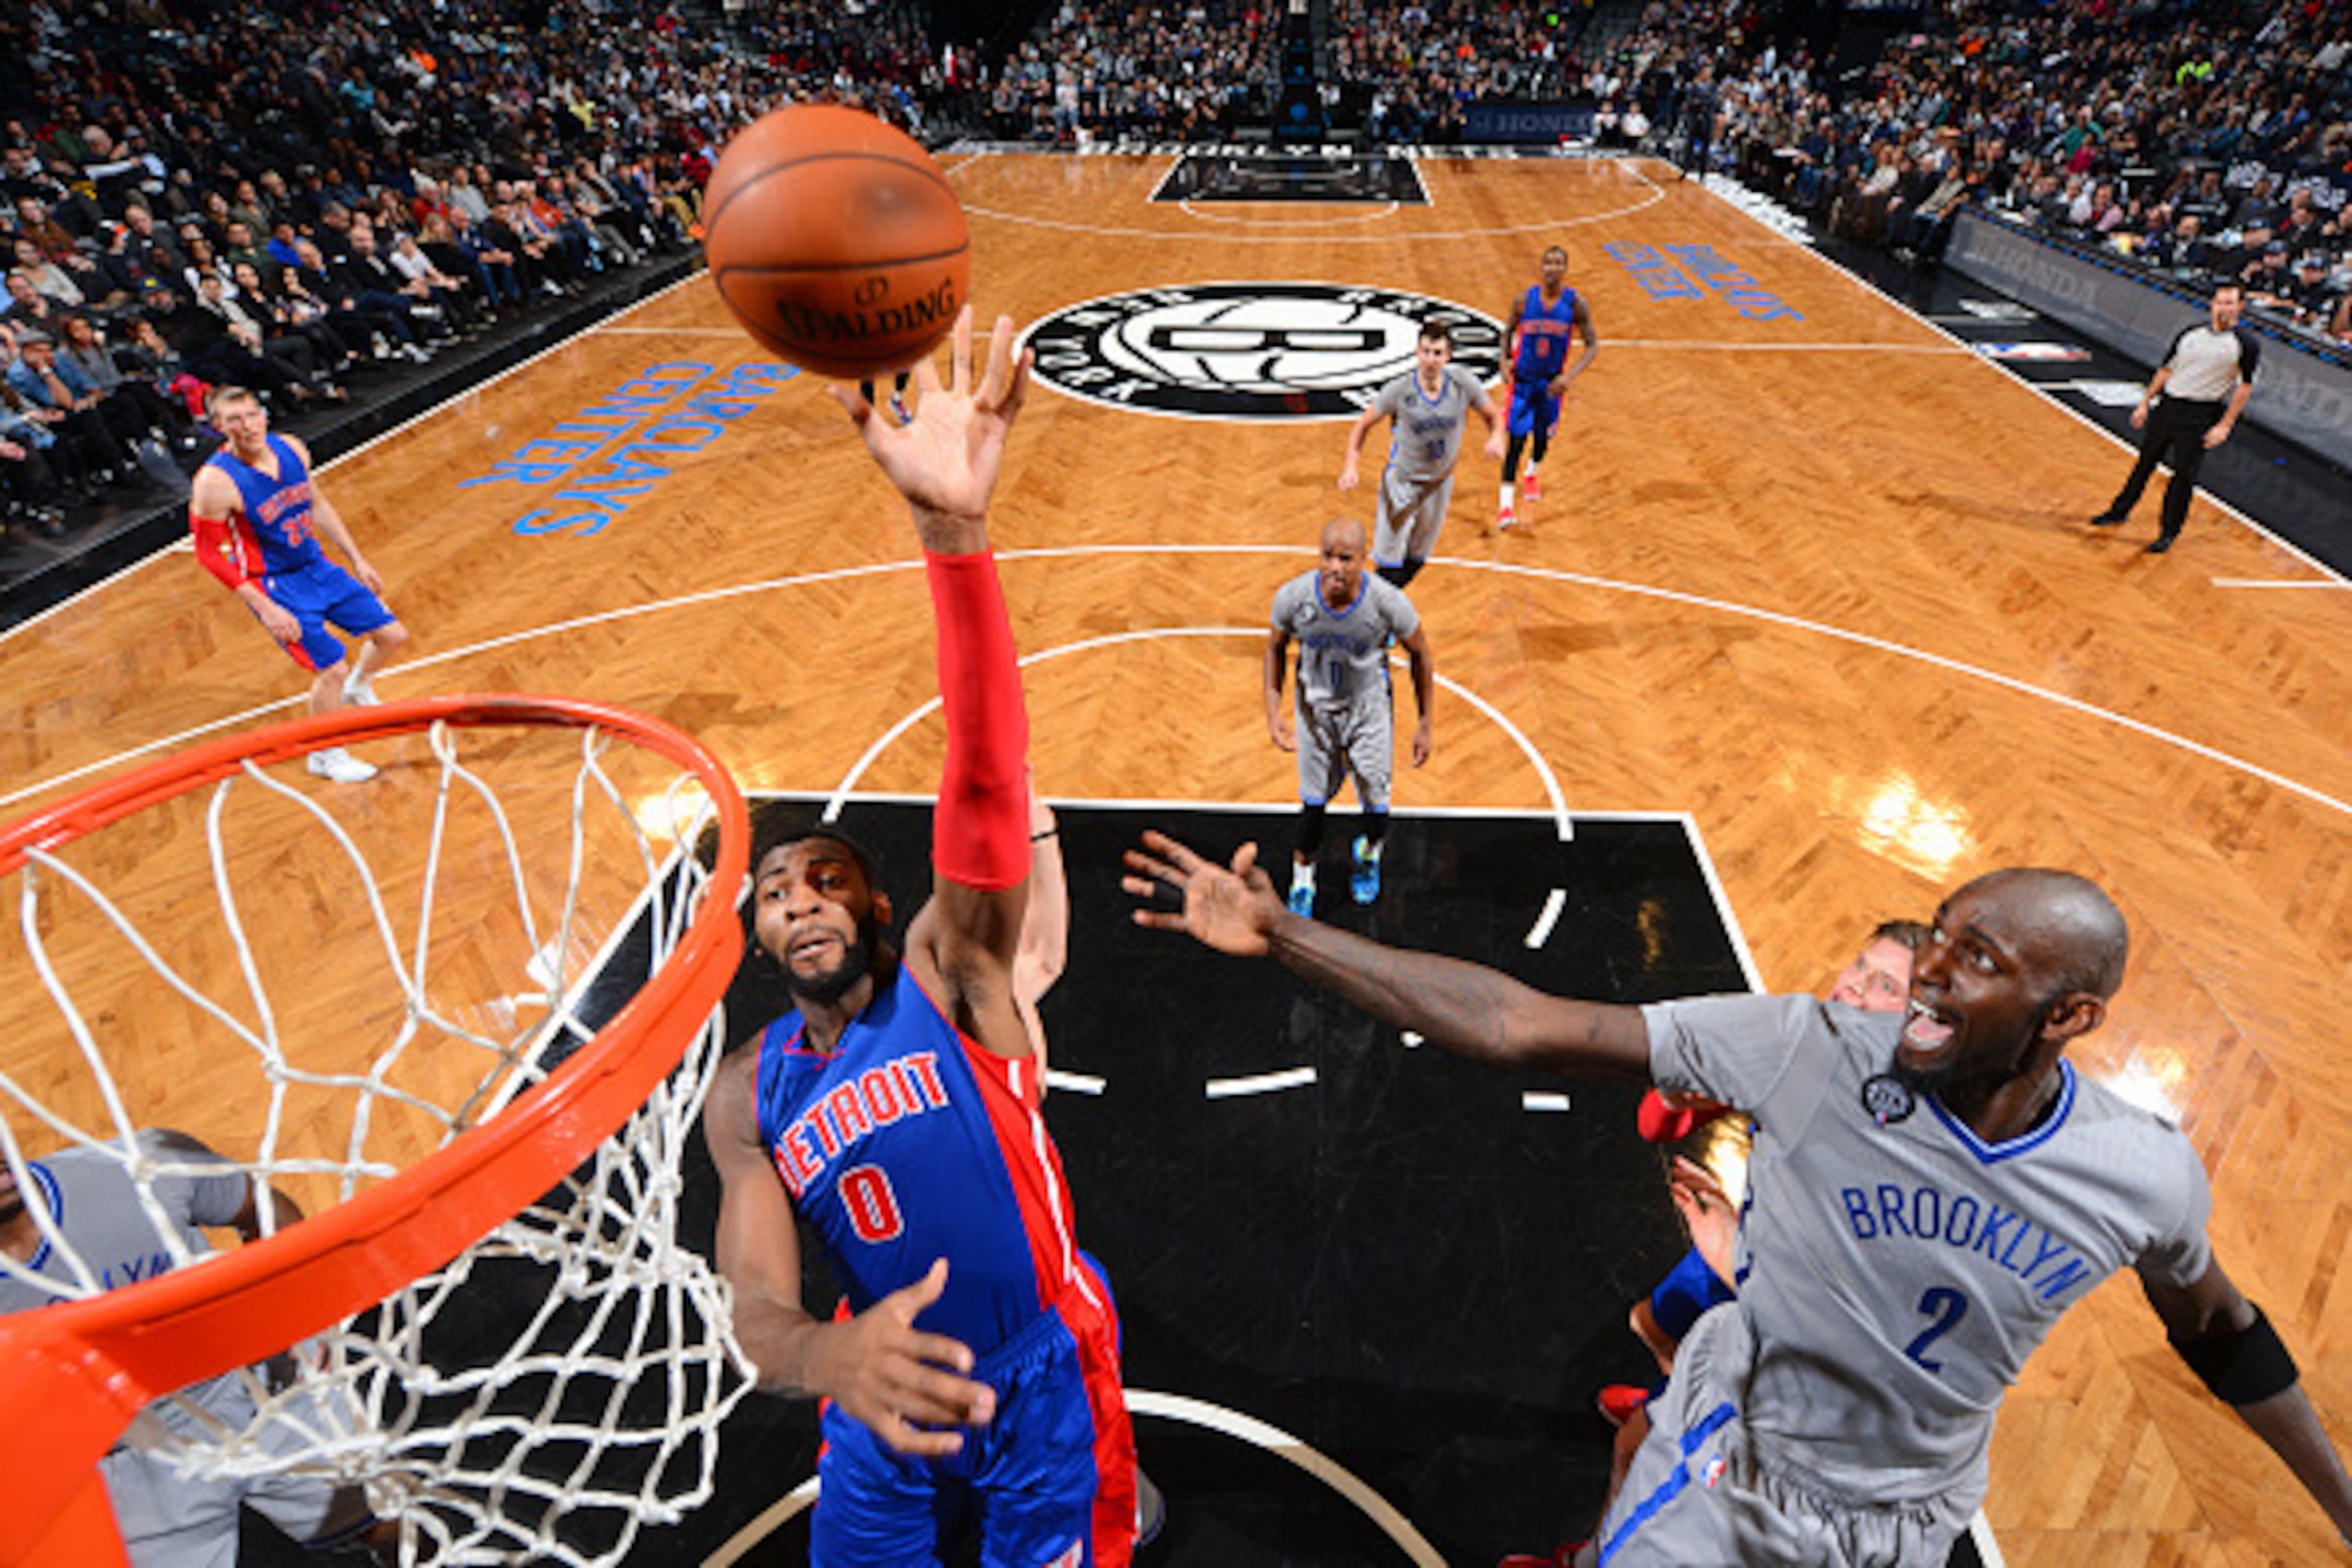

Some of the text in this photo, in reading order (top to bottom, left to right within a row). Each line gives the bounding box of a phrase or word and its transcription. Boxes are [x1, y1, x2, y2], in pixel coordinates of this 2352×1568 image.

[775, 278, 955, 340] SPALDING
[457, 361, 714, 489] CENTER
[512, 363, 802, 536] BARCLAYS
[837, 1164, 905, 1244] 0
[1841, 1184, 2092, 1302] BROOKLYN
[1903, 1287, 1968, 1375] 2
